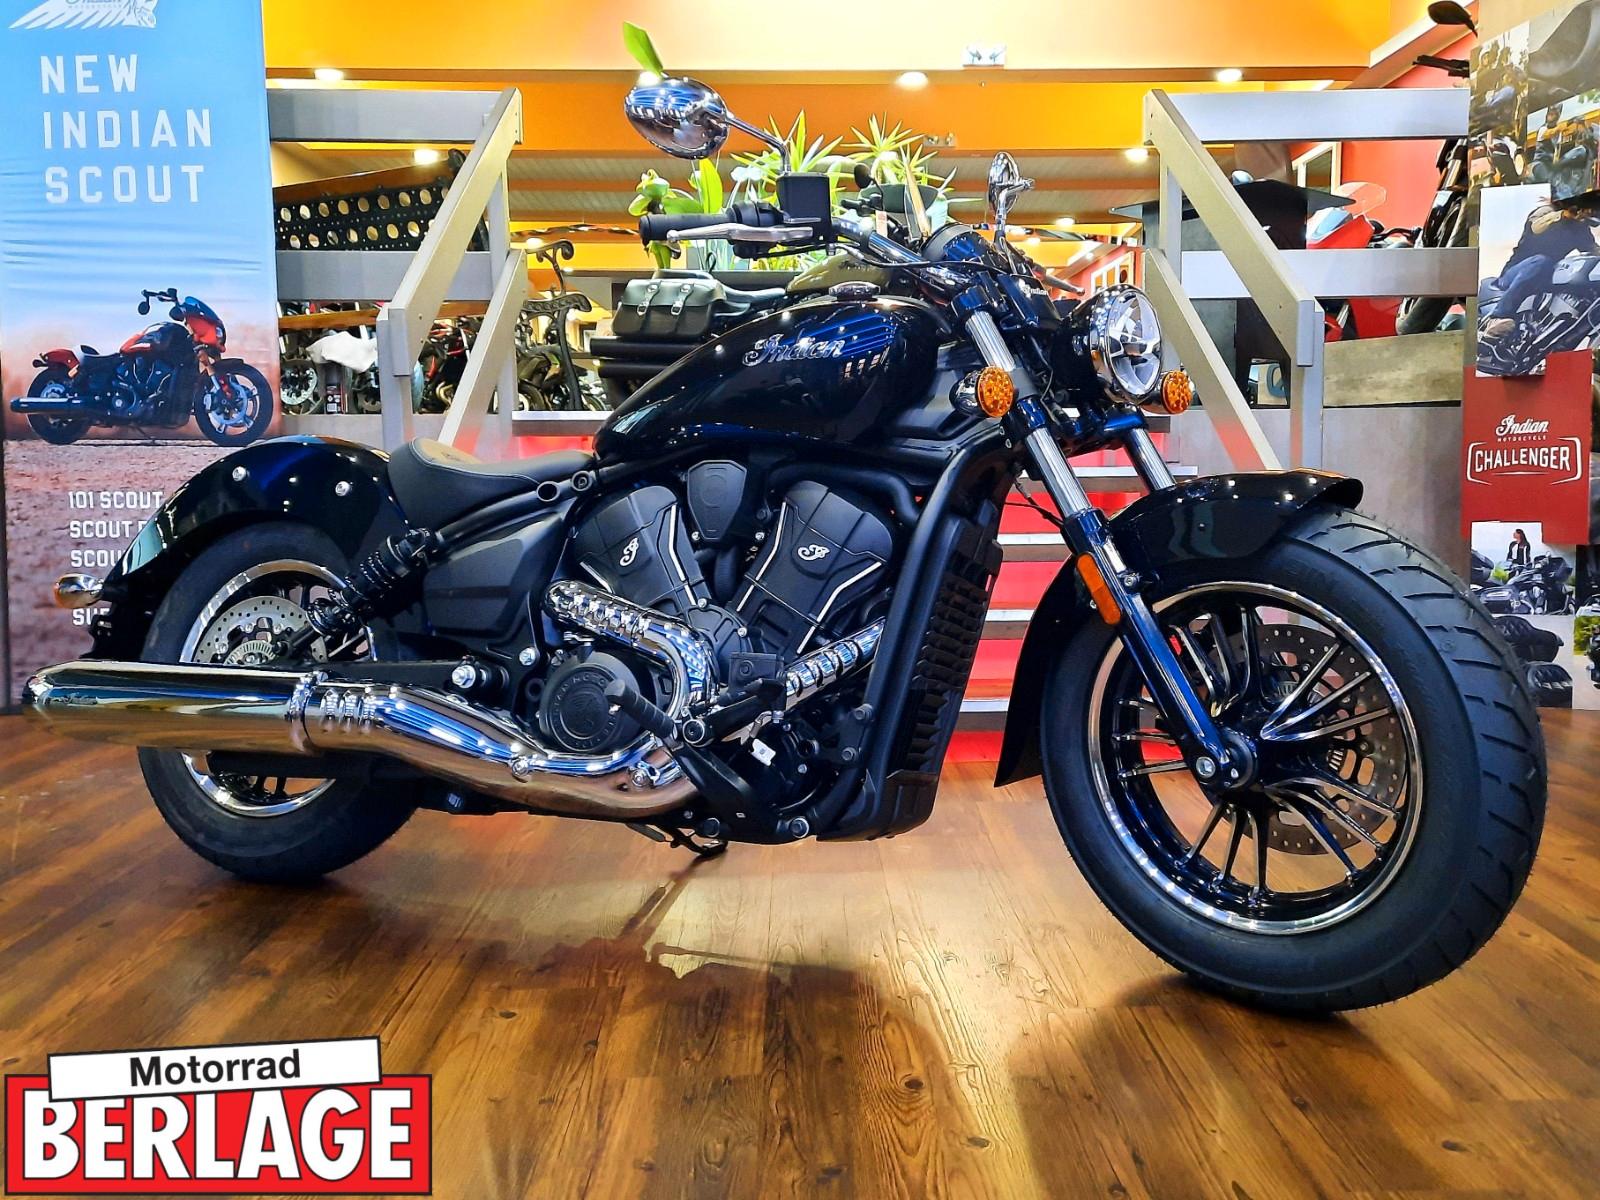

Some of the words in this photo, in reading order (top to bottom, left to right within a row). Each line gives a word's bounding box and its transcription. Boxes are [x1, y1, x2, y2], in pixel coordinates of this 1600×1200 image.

[40, 54, 138, 94] NEW
[43, 108, 212, 149] INDIAN
[45, 165, 205, 204] SCOUT
[742, 333, 846, 367] Indian
[1495, 414, 1549, 436] Indian
[1475, 446, 1570, 473] CHALLENGER
[68, 491, 94, 509] 101
[100, 491, 163, 509] SCOUT
[69, 520, 133, 538] SCOUT
[71, 549, 125, 568] SCOU
